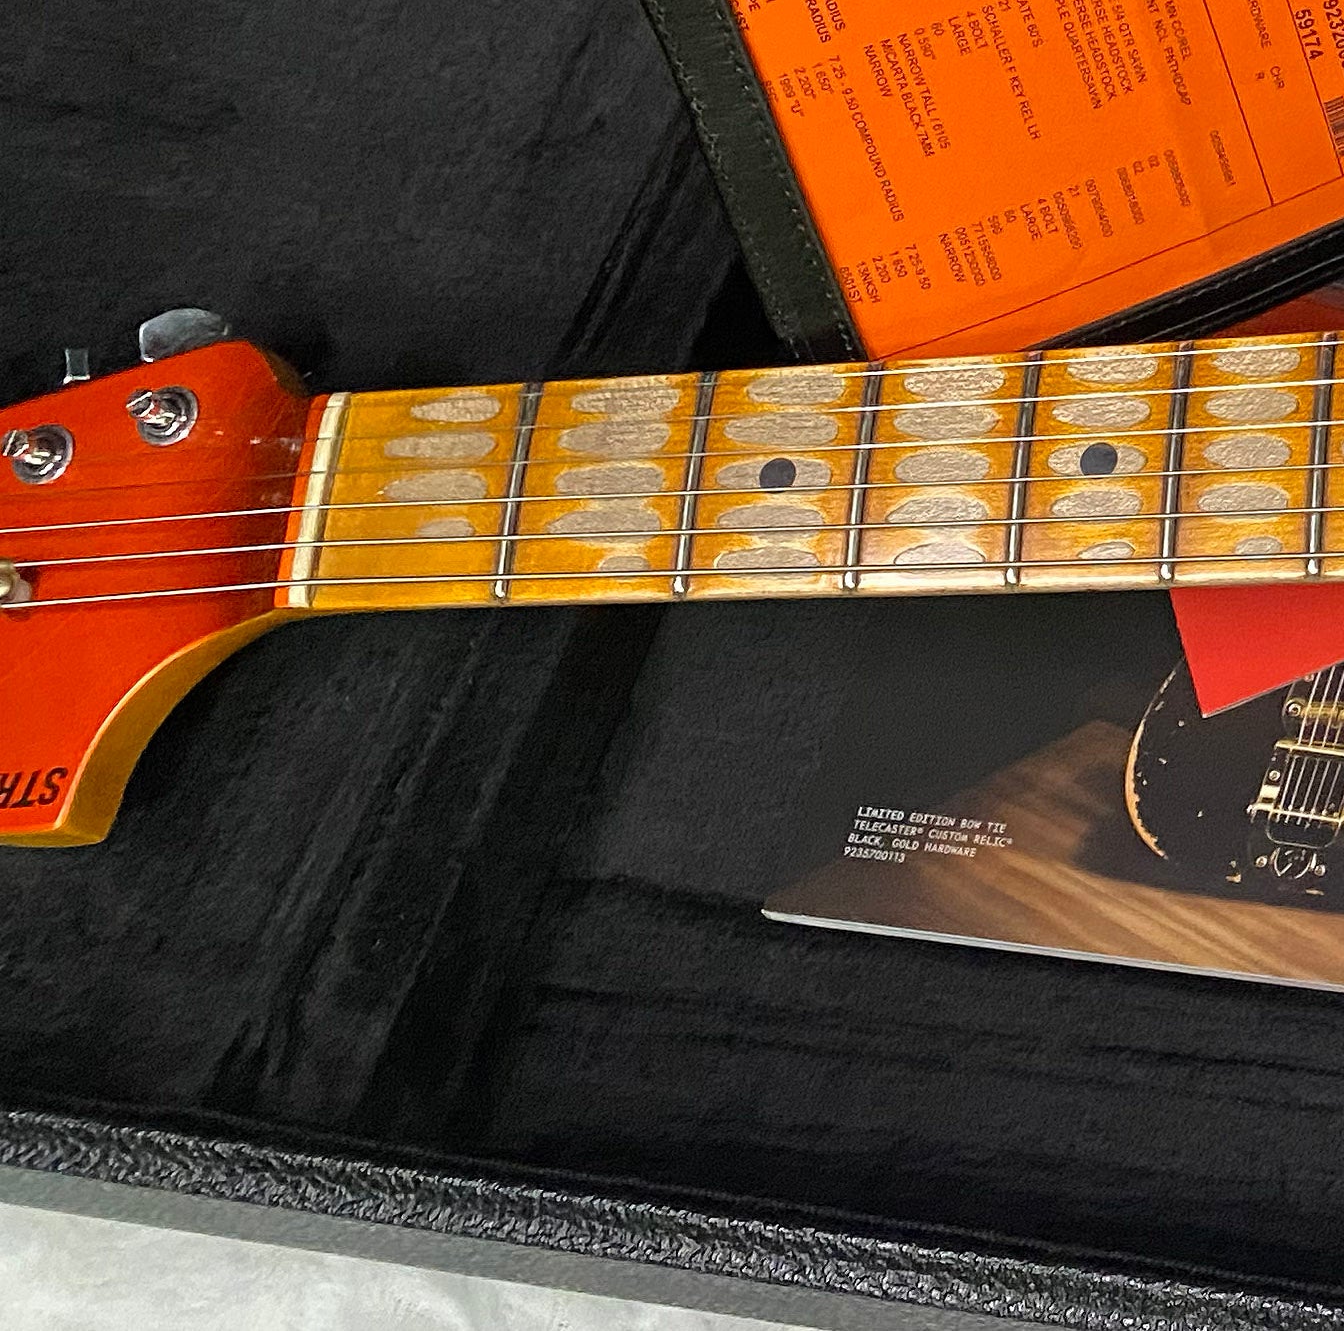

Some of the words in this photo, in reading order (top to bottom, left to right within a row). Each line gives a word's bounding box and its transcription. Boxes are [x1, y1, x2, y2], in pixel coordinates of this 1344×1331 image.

[1294, 8, 1325, 61] 59174
[857, 807, 904, 820] LIMITED
[910, 813, 955, 826] EDITION
[960, 819, 981, 829] BOW
[988, 822, 1007, 833] TIE
[848, 833, 885, 847] BLACK,
[892, 838, 919, 851] GOLD
[924, 842, 977, 857] HARDWARE
[928, 829, 968, 842] CUSTOM
